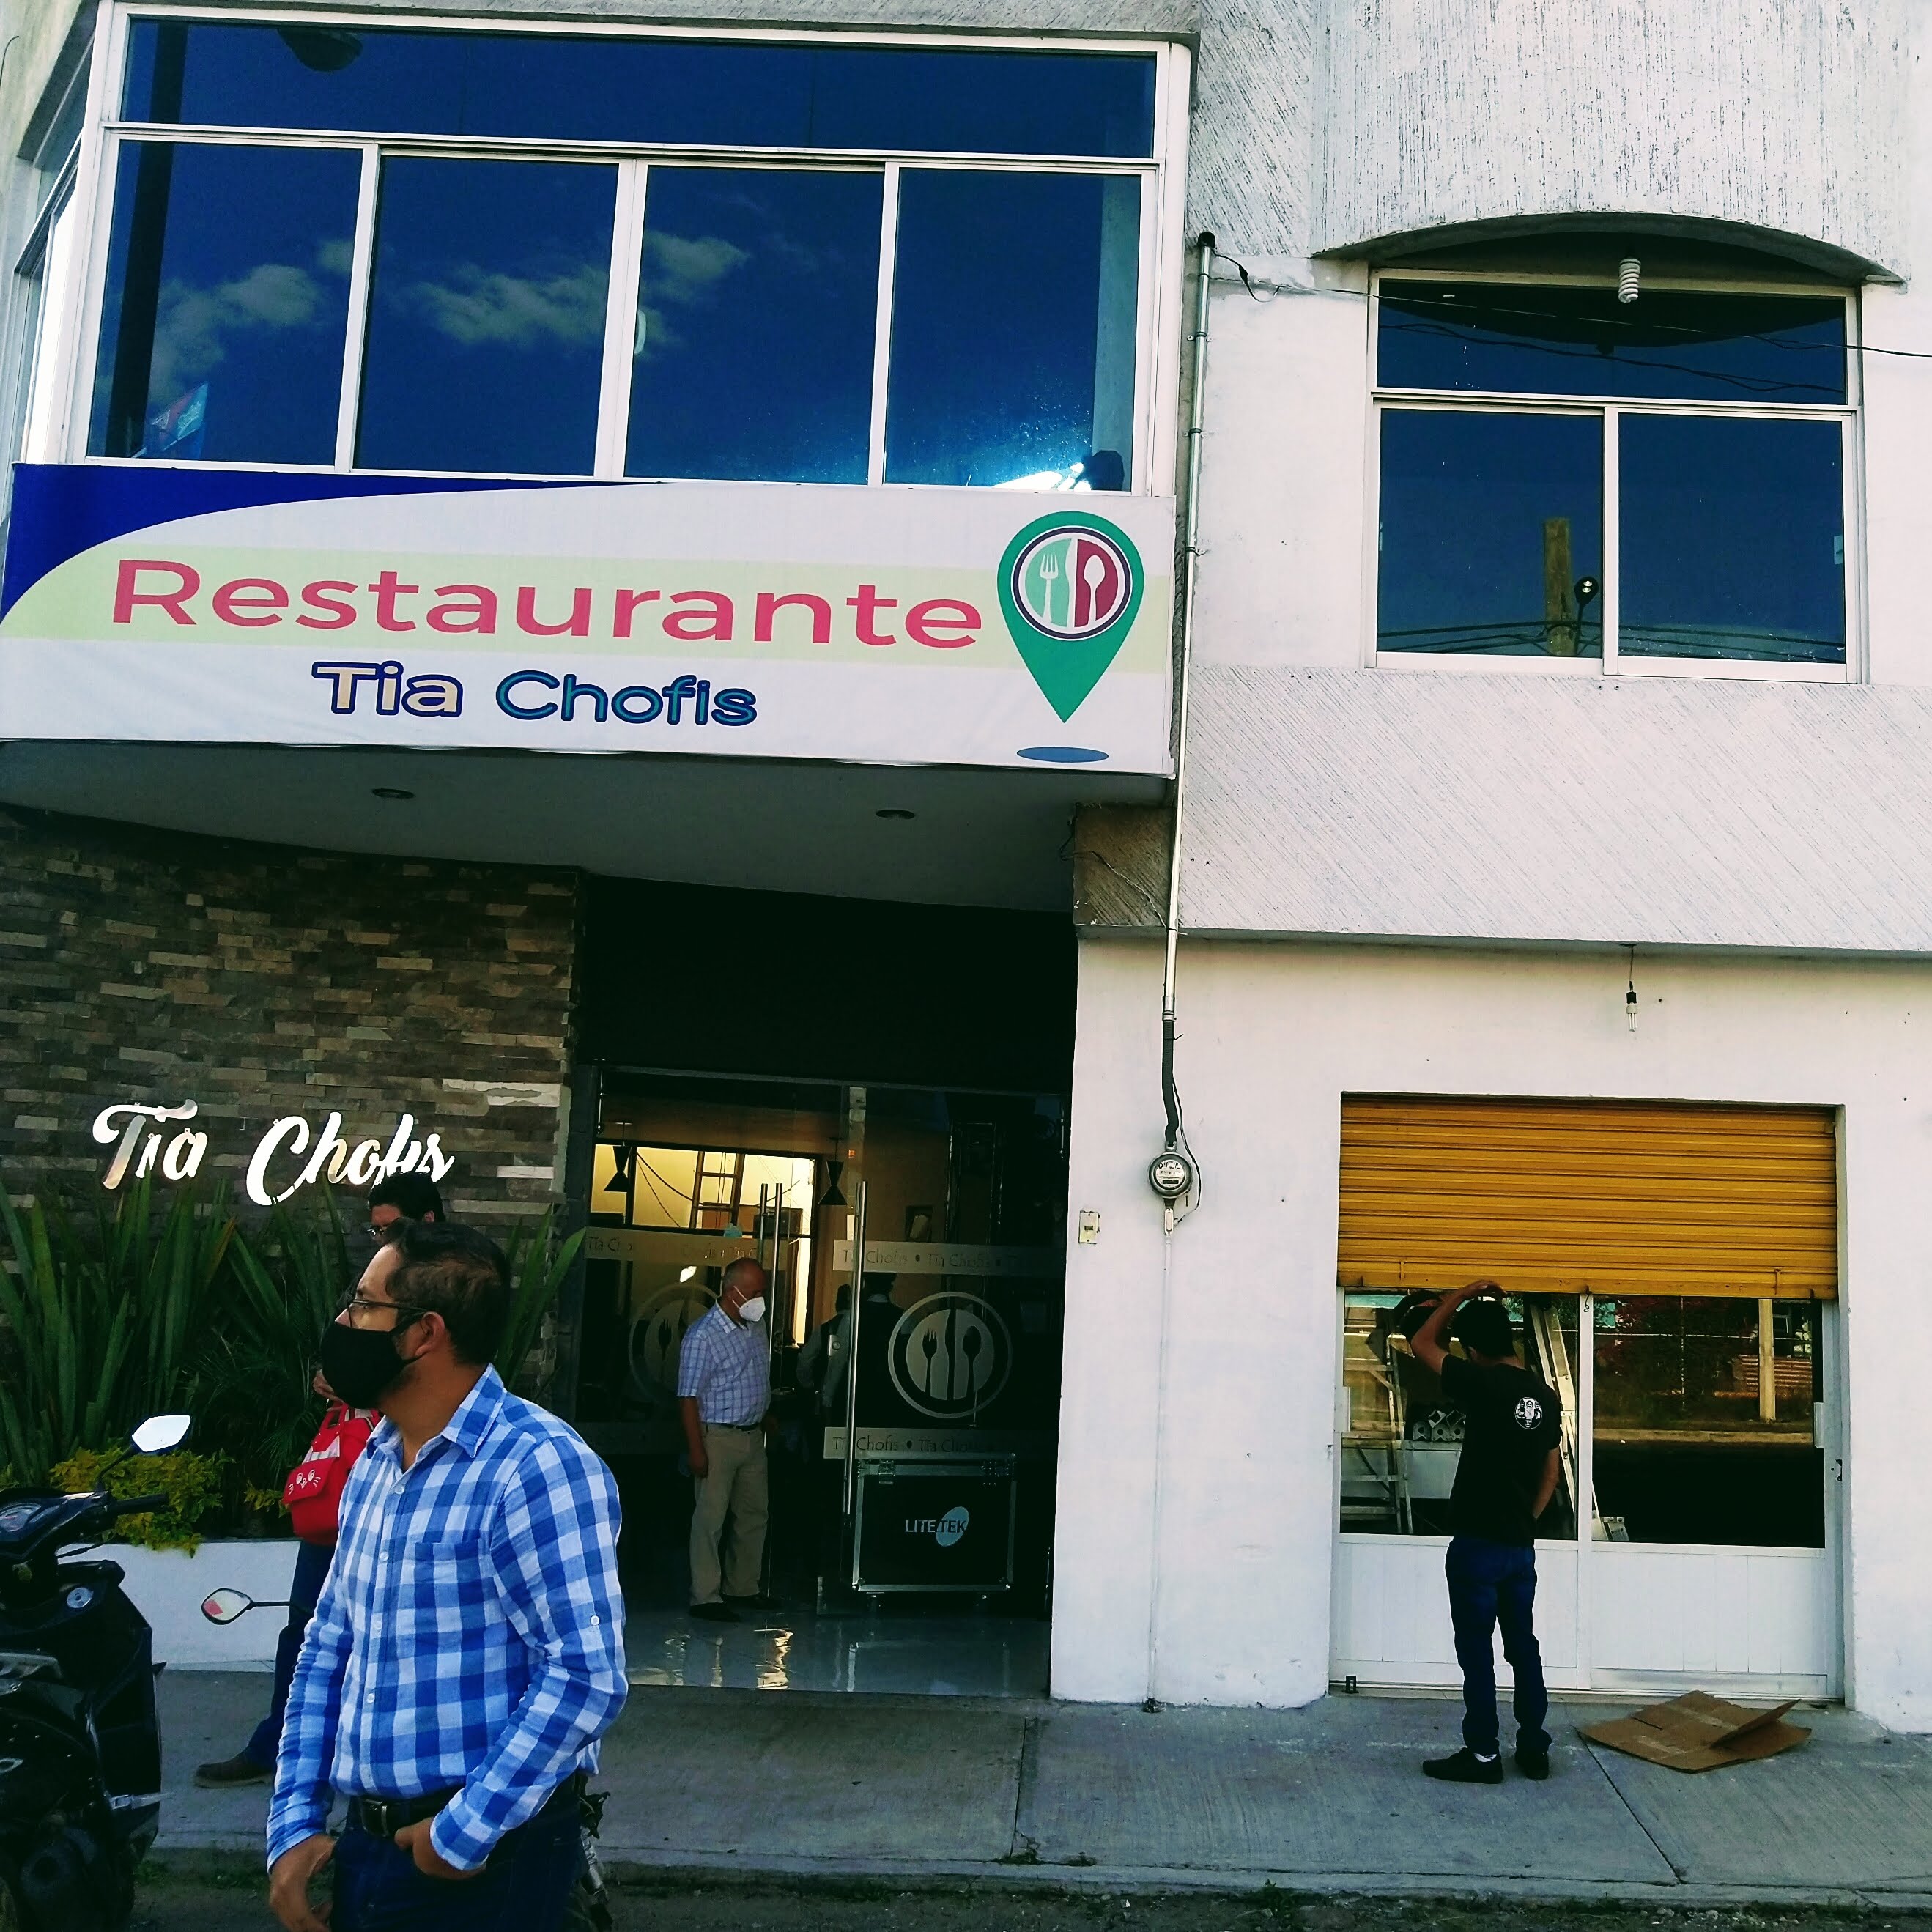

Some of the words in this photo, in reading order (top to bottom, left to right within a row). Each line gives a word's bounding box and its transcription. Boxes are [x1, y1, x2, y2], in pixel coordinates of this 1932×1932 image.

[112, 558, 982, 649] Restaurante
[311, 660, 463, 718] Tia
[495, 670, 758, 727] Chofis
